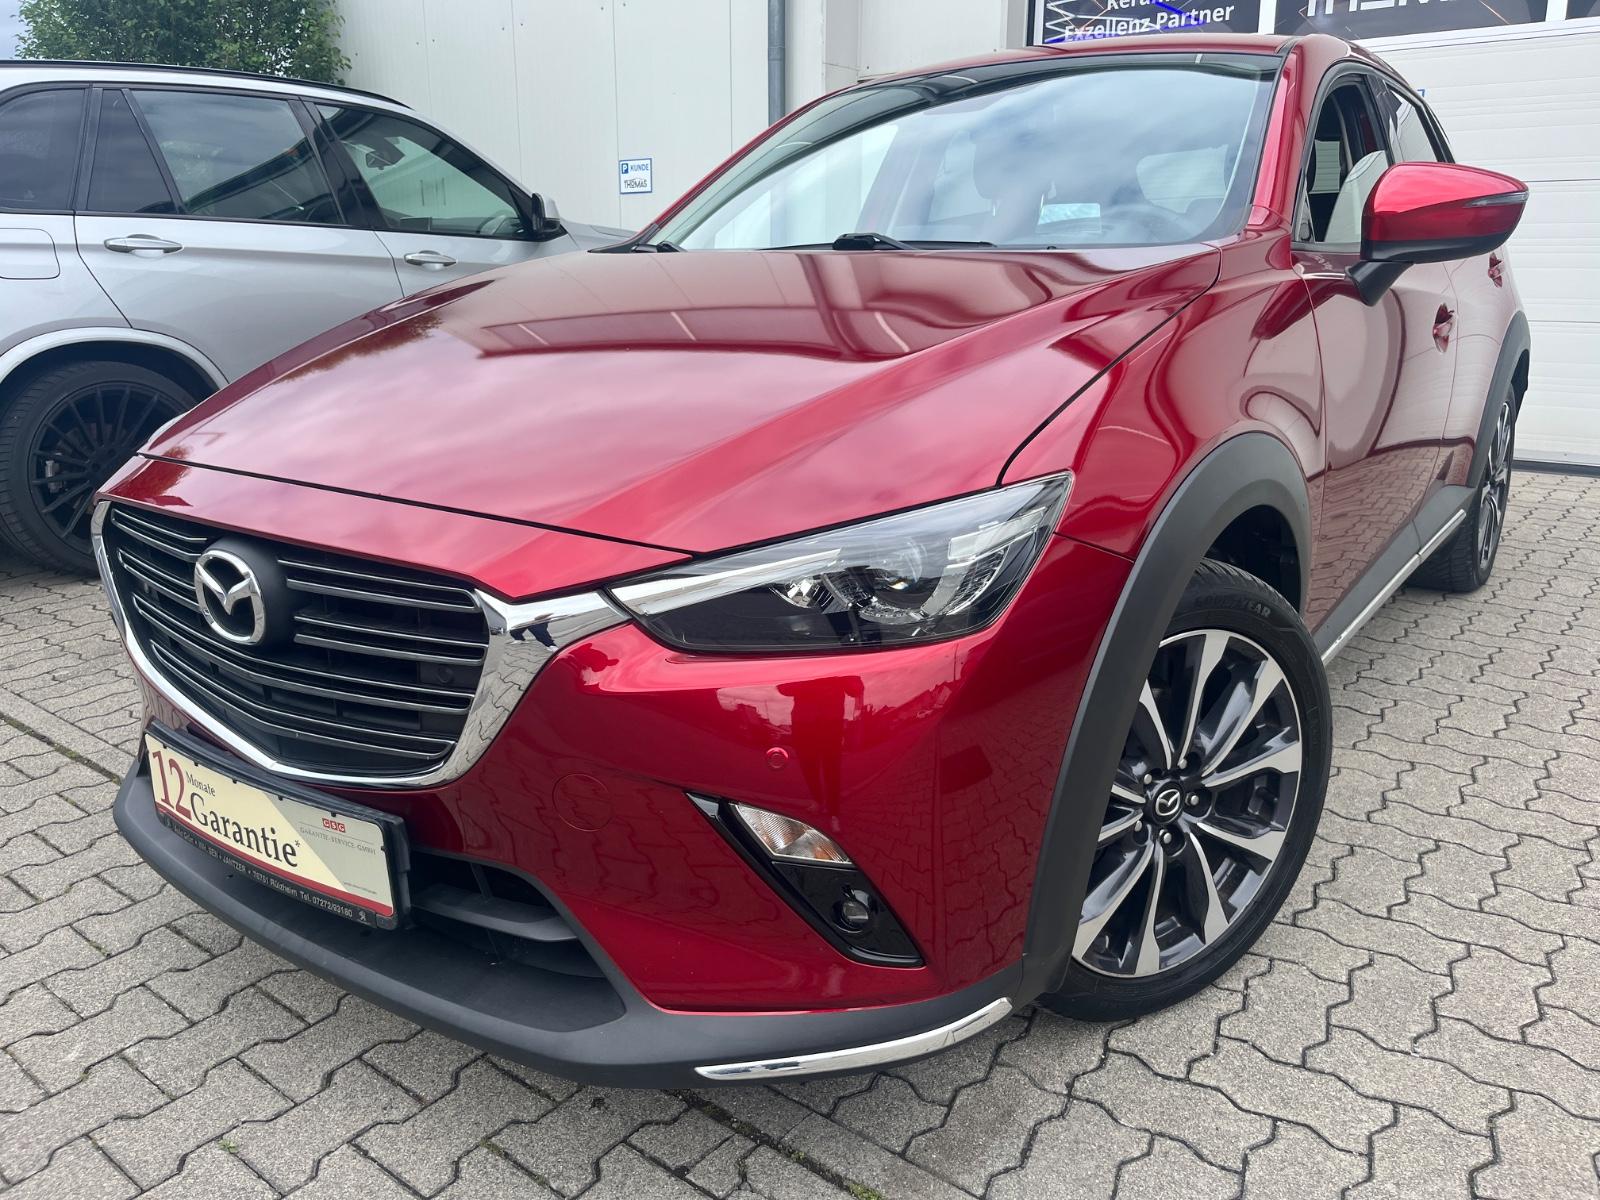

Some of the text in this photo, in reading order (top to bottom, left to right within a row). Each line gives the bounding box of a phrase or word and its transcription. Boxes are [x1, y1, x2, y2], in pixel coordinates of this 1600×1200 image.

[1064, 5, 1235, 42] Exzellenz Partner
[630, 163, 649, 171] KUNDE
[624, 179, 648, 188] THOMAS
[152, 751, 216, 821] 12 Monate
